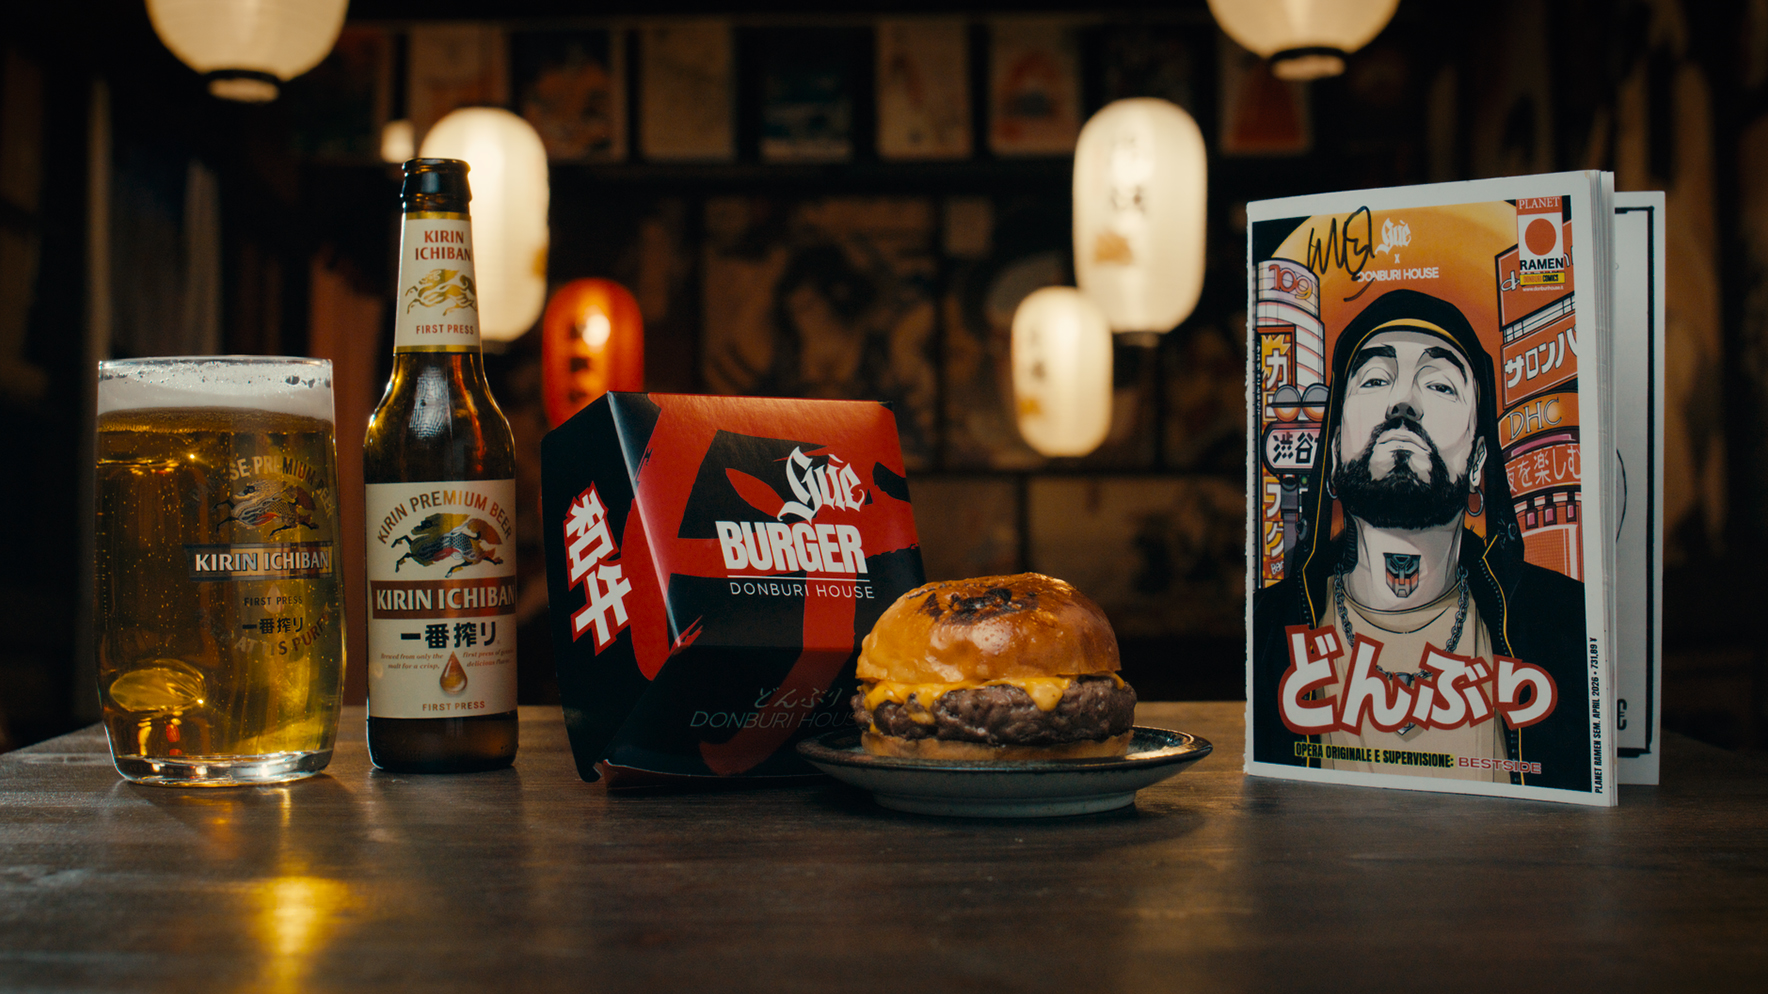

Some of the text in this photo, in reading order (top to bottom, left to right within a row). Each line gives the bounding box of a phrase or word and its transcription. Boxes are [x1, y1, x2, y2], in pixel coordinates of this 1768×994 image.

[1518, 196, 1561, 209] PLANET
[424, 230, 464, 244] KIRIN
[415, 246, 471, 261] ICHIBAN
[1519, 257, 1564, 271] RAMEN
[1268, 264, 1313, 300] 109
[1357, 267, 1439, 282] DONBURI HOUSE
[416, 324, 474, 335] FIRST PRESS
[1508, 397, 1562, 440] DHC
[377, 490, 513, 544] KIRIN PREMIUM BEER
[715, 520, 868, 574] BURGER
[195, 550, 330, 572] KIRIN ICHIBAN
[244, 596, 303, 606] FIRST PRESS
[376, 584, 515, 611] KIRIN ICHIBAN
[730, 582, 875, 599] DONBURI HOUSE
[242, 617, 304, 634] 一番搾り
[400, 621, 496, 649] 一番搾り
[416, 653, 431, 661] only
[1281, 628, 1555, 731] どんぶり
[1591, 676, 1600, 697] 2026
[422, 700, 486, 712] FIRST PRESS
[754, 688, 843, 709] どんぶり
[1592, 698, 1601, 719] APRIL
[690, 711, 856, 728] DONBURI HOUS
[1593, 720, 1601, 739] SEM.
[1296, 742, 1542, 774] OPERA ORIGINALE E SUPERVISIONE: BESTSIDE
[1593, 740, 1602, 766] RAMEN
[1594, 767, 1603, 794] PLANET
